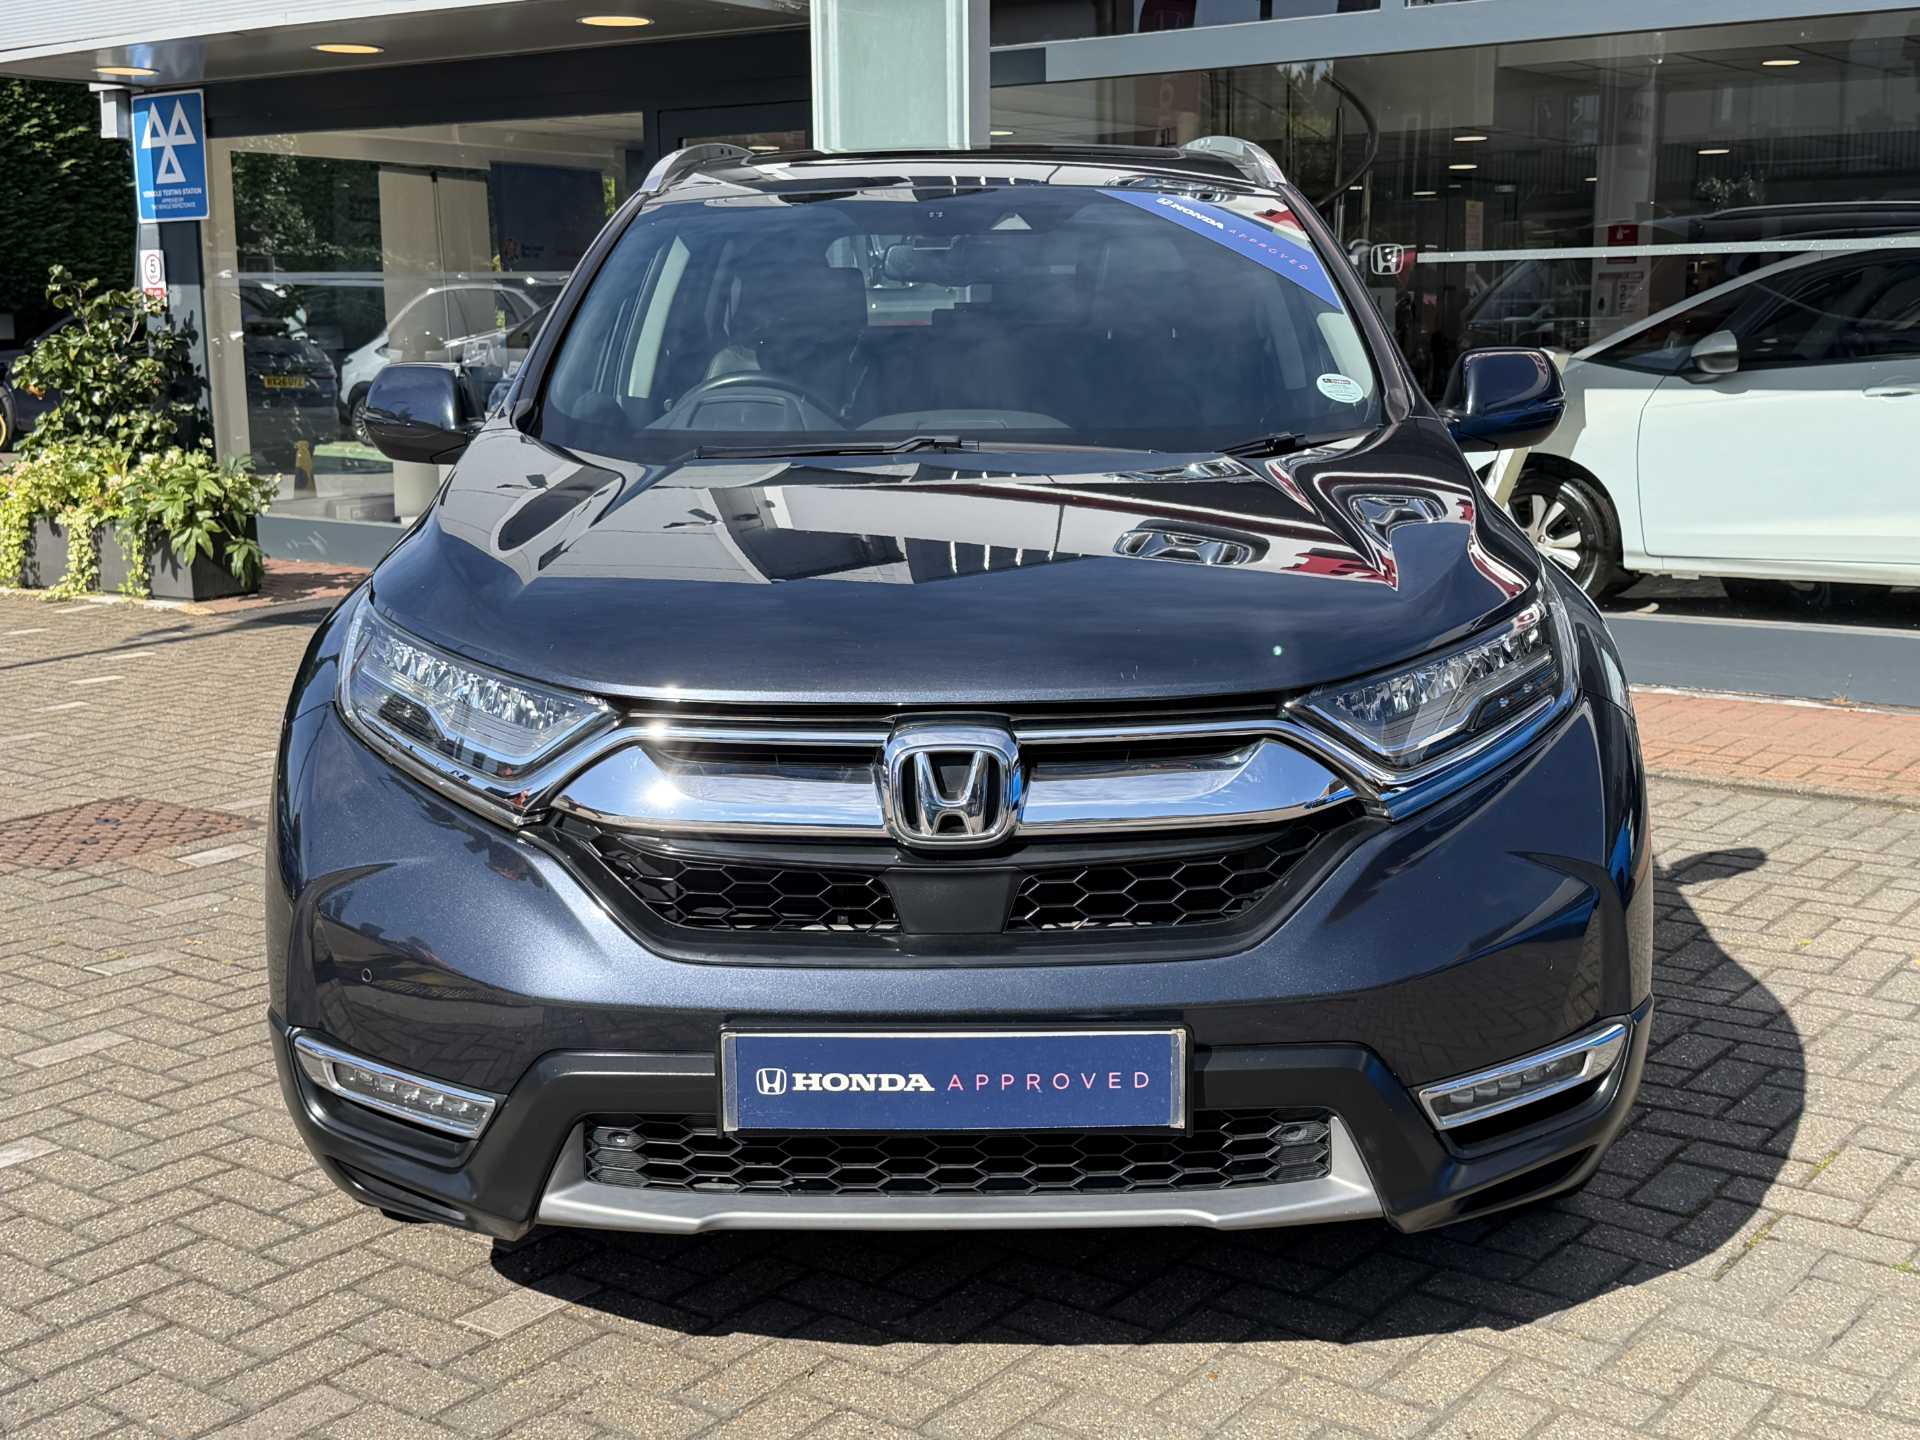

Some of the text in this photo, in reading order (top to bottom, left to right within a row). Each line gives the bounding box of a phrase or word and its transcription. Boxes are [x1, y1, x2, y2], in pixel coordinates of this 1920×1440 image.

[150, 259, 157, 273] 5
[792, 1073, 936, 1092] HONDA
[947, 1072, 1150, 1091] APPROVED
